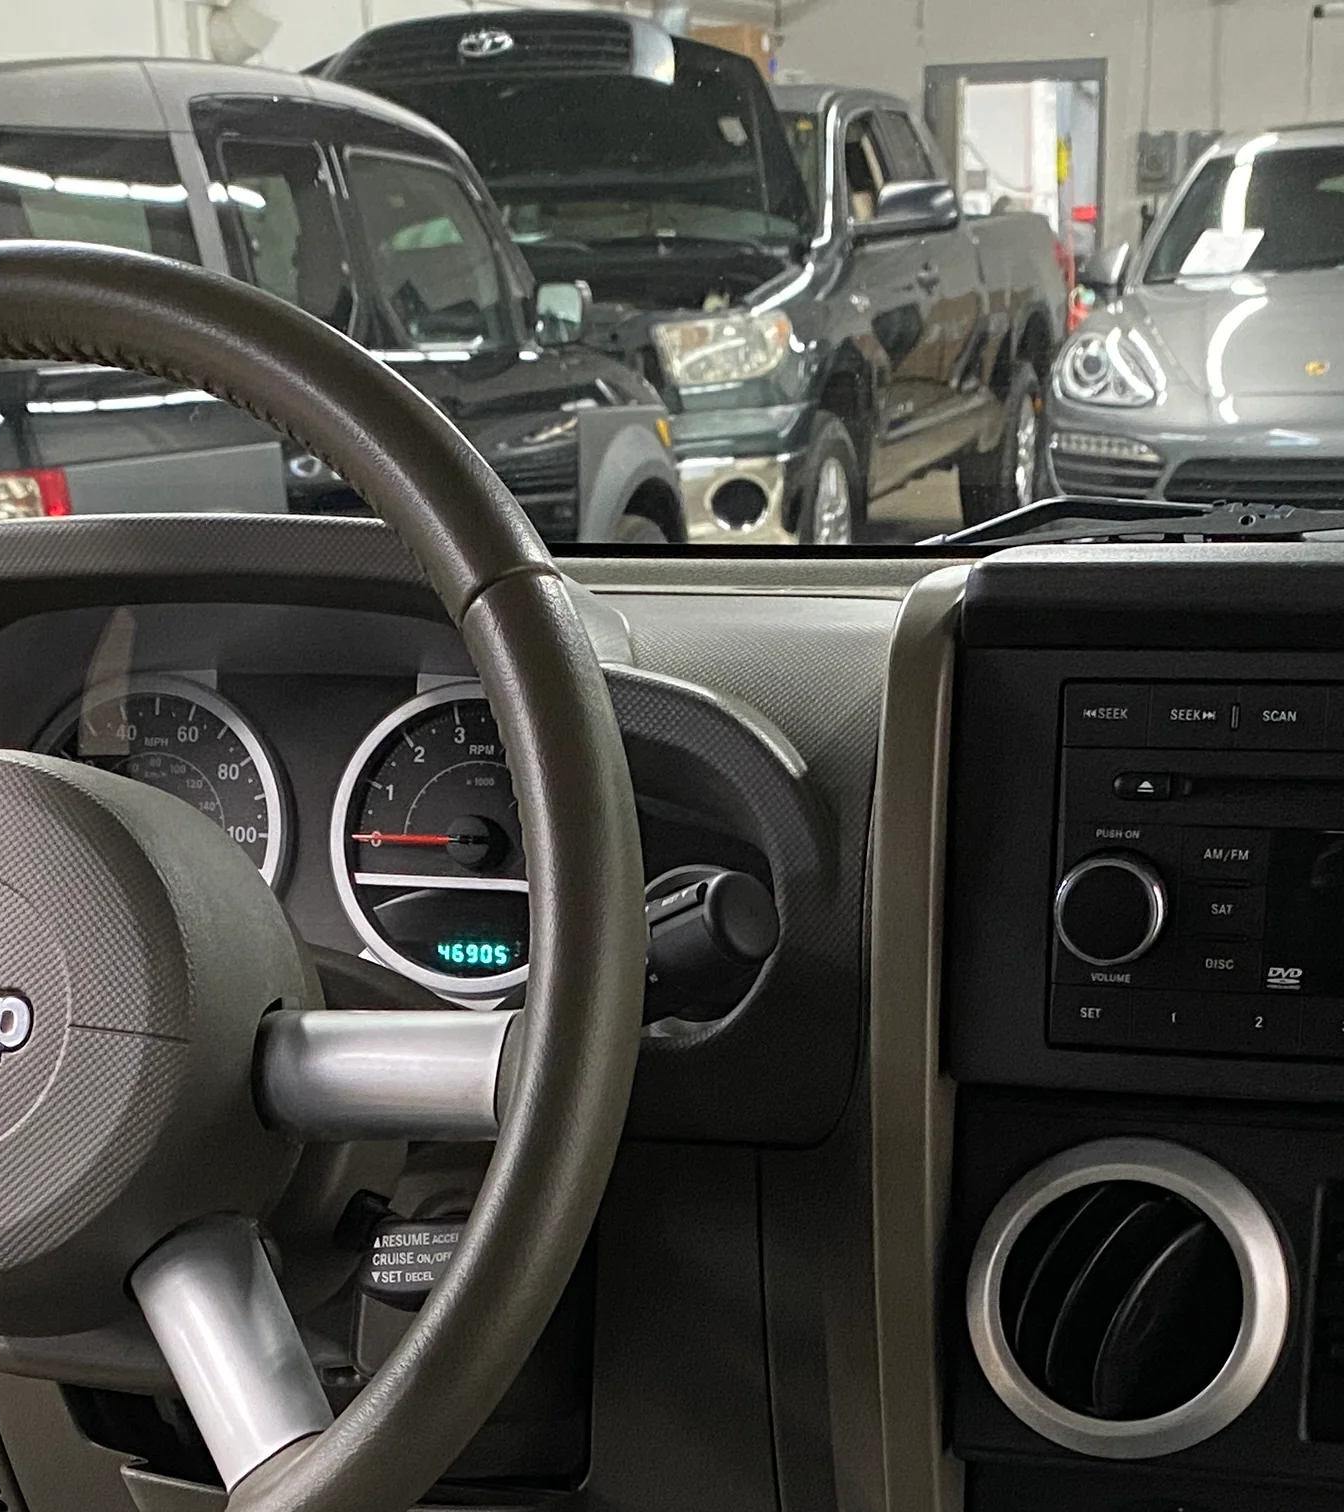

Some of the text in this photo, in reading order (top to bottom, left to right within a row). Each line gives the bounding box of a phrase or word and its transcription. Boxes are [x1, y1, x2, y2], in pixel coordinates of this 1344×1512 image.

[1097, 708, 1128, 720] SEEK
[1170, 709, 1201, 721] SEEK
[1262, 710, 1297, 722] SCAN
[116, 725, 137, 740] 40
[177, 727, 199, 743] 60
[454, 726, 466, 744] 3
[144, 737, 169, 748] MPH
[413, 746, 425, 763] 2
[469, 744, 495, 755] RPM
[217, 763, 240, 780] 80
[185, 778, 203, 790] 120
[385, 784, 394, 800] 1
[226, 826, 257, 843] 100
[1096, 828, 1140, 840] PUSH ON
[1203, 848, 1249, 861] AM/FM
[1211, 903, 1233, 915] SAT
[438, 943, 508, 965] 46905
[1205, 958, 1234, 970] DISC
[1091, 971, 1132, 983] VOLUME
[1267, 967, 1303, 978] DVD
[1080, 1007, 1101, 1019] SET
[1255, 1016, 1263, 1028] 2
[382, 1232, 430, 1248] RESUME
[372, 1251, 415, 1266] CRUISE
[381, 1270, 435, 1283] SET DECEL
